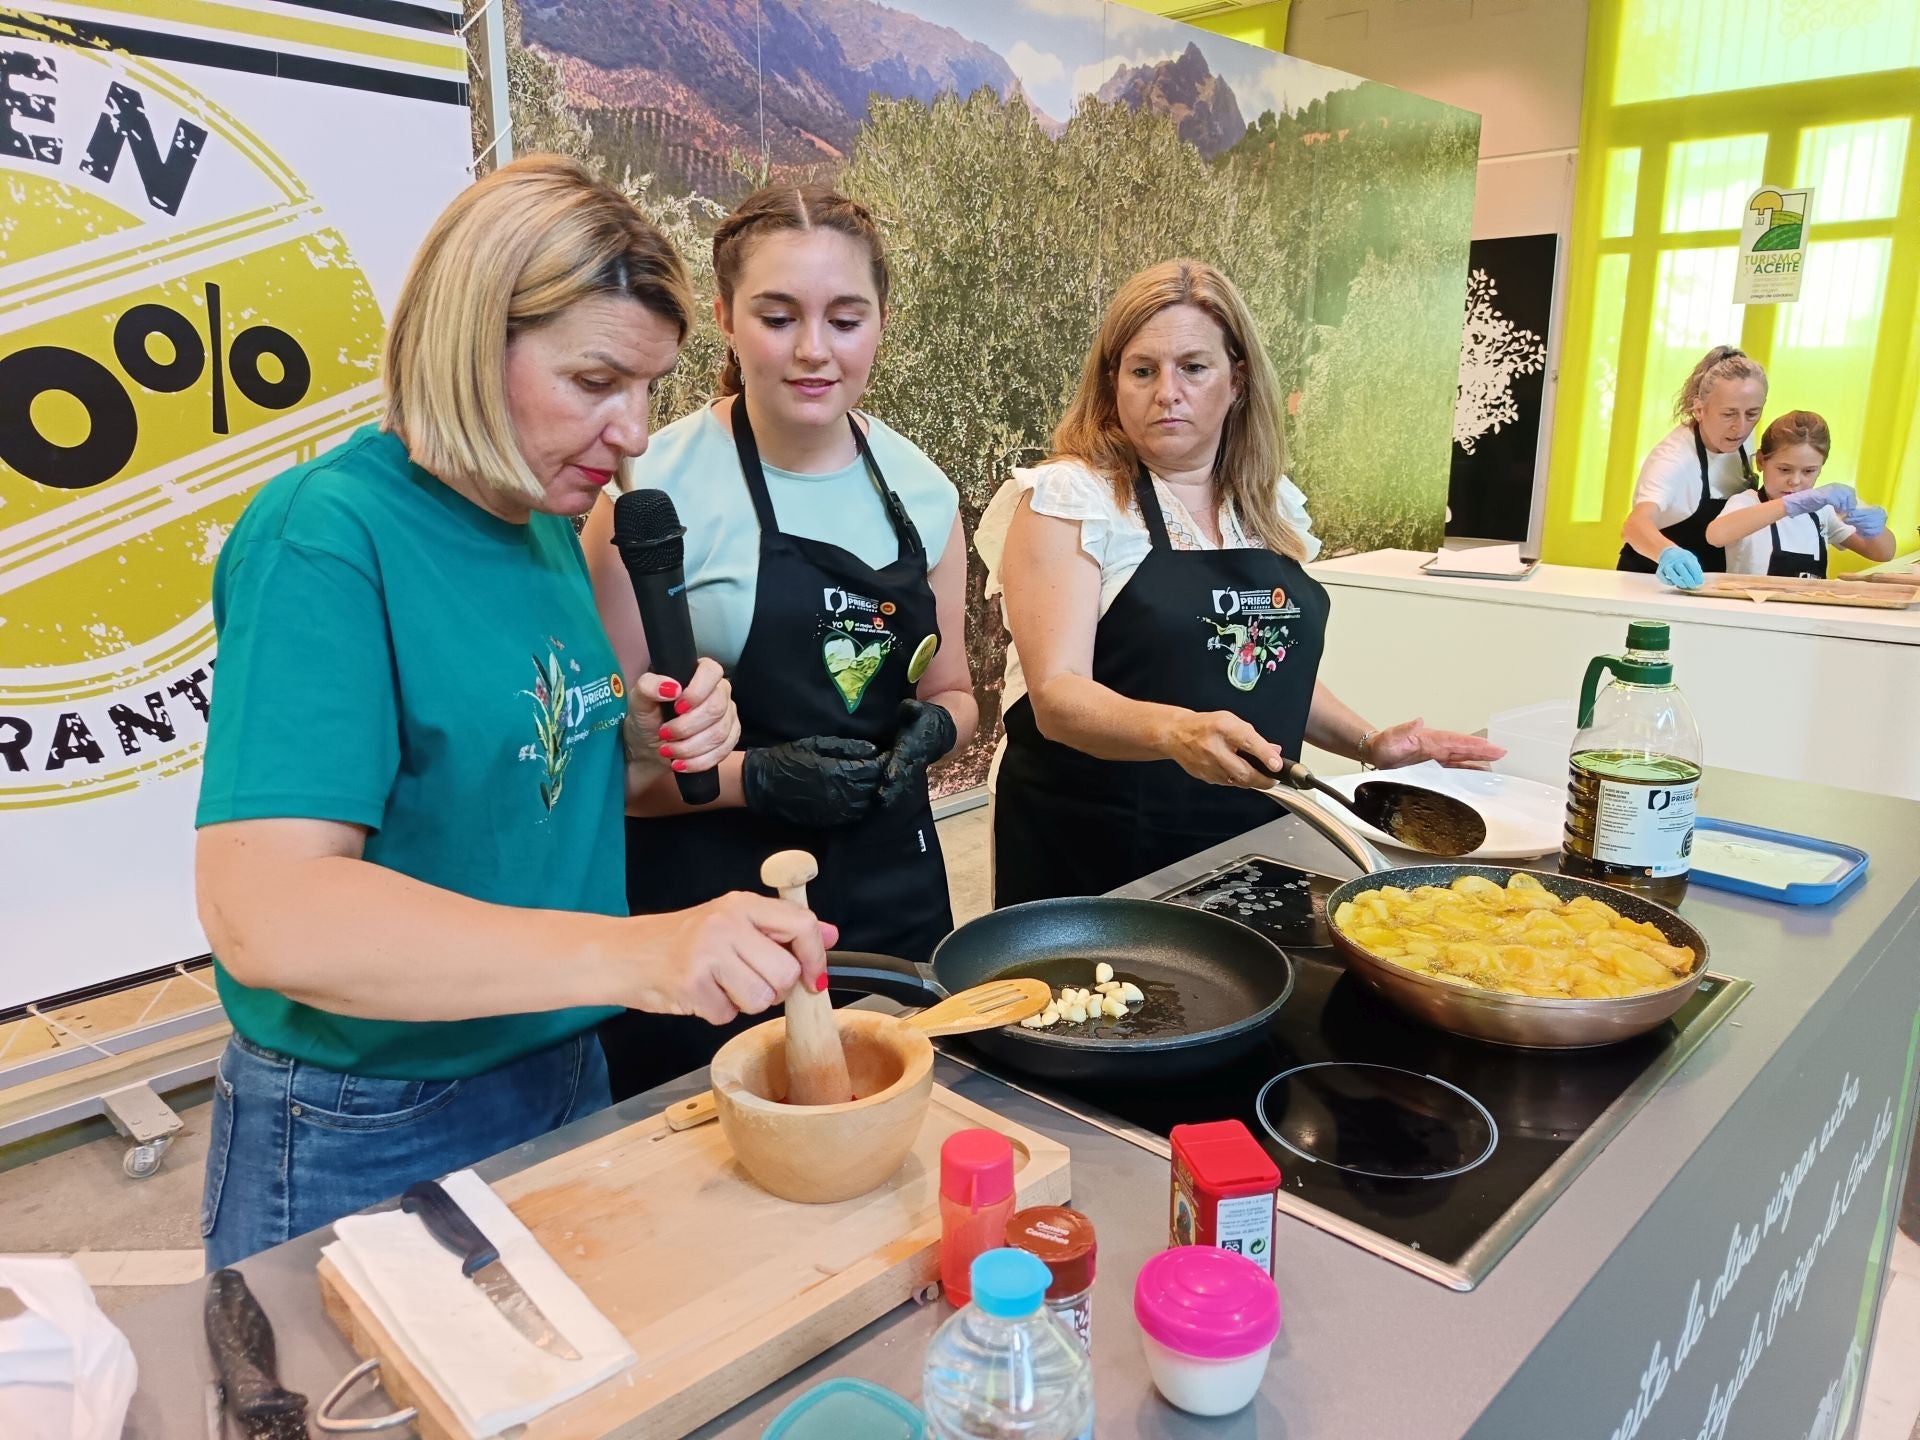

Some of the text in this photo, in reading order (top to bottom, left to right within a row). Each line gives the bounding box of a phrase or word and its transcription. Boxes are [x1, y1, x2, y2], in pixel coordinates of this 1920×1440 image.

[1744, 253, 1802, 265] TURISMO
[1754, 263, 1799, 274] ACEITE
[848, 598, 879, 609] PRIEGO
[1240, 596, 1271, 605] PRIEGO
[832, 620, 844, 629] YO
[583, 685, 611, 707] PRIEGO
[0, 658, 217, 772] RANT
[1607, 1071, 1860, 1440] eite de oliva virgen extra
[1766, 1233, 1823, 1348] Priego
[1822, 1180, 1841, 1247] de
